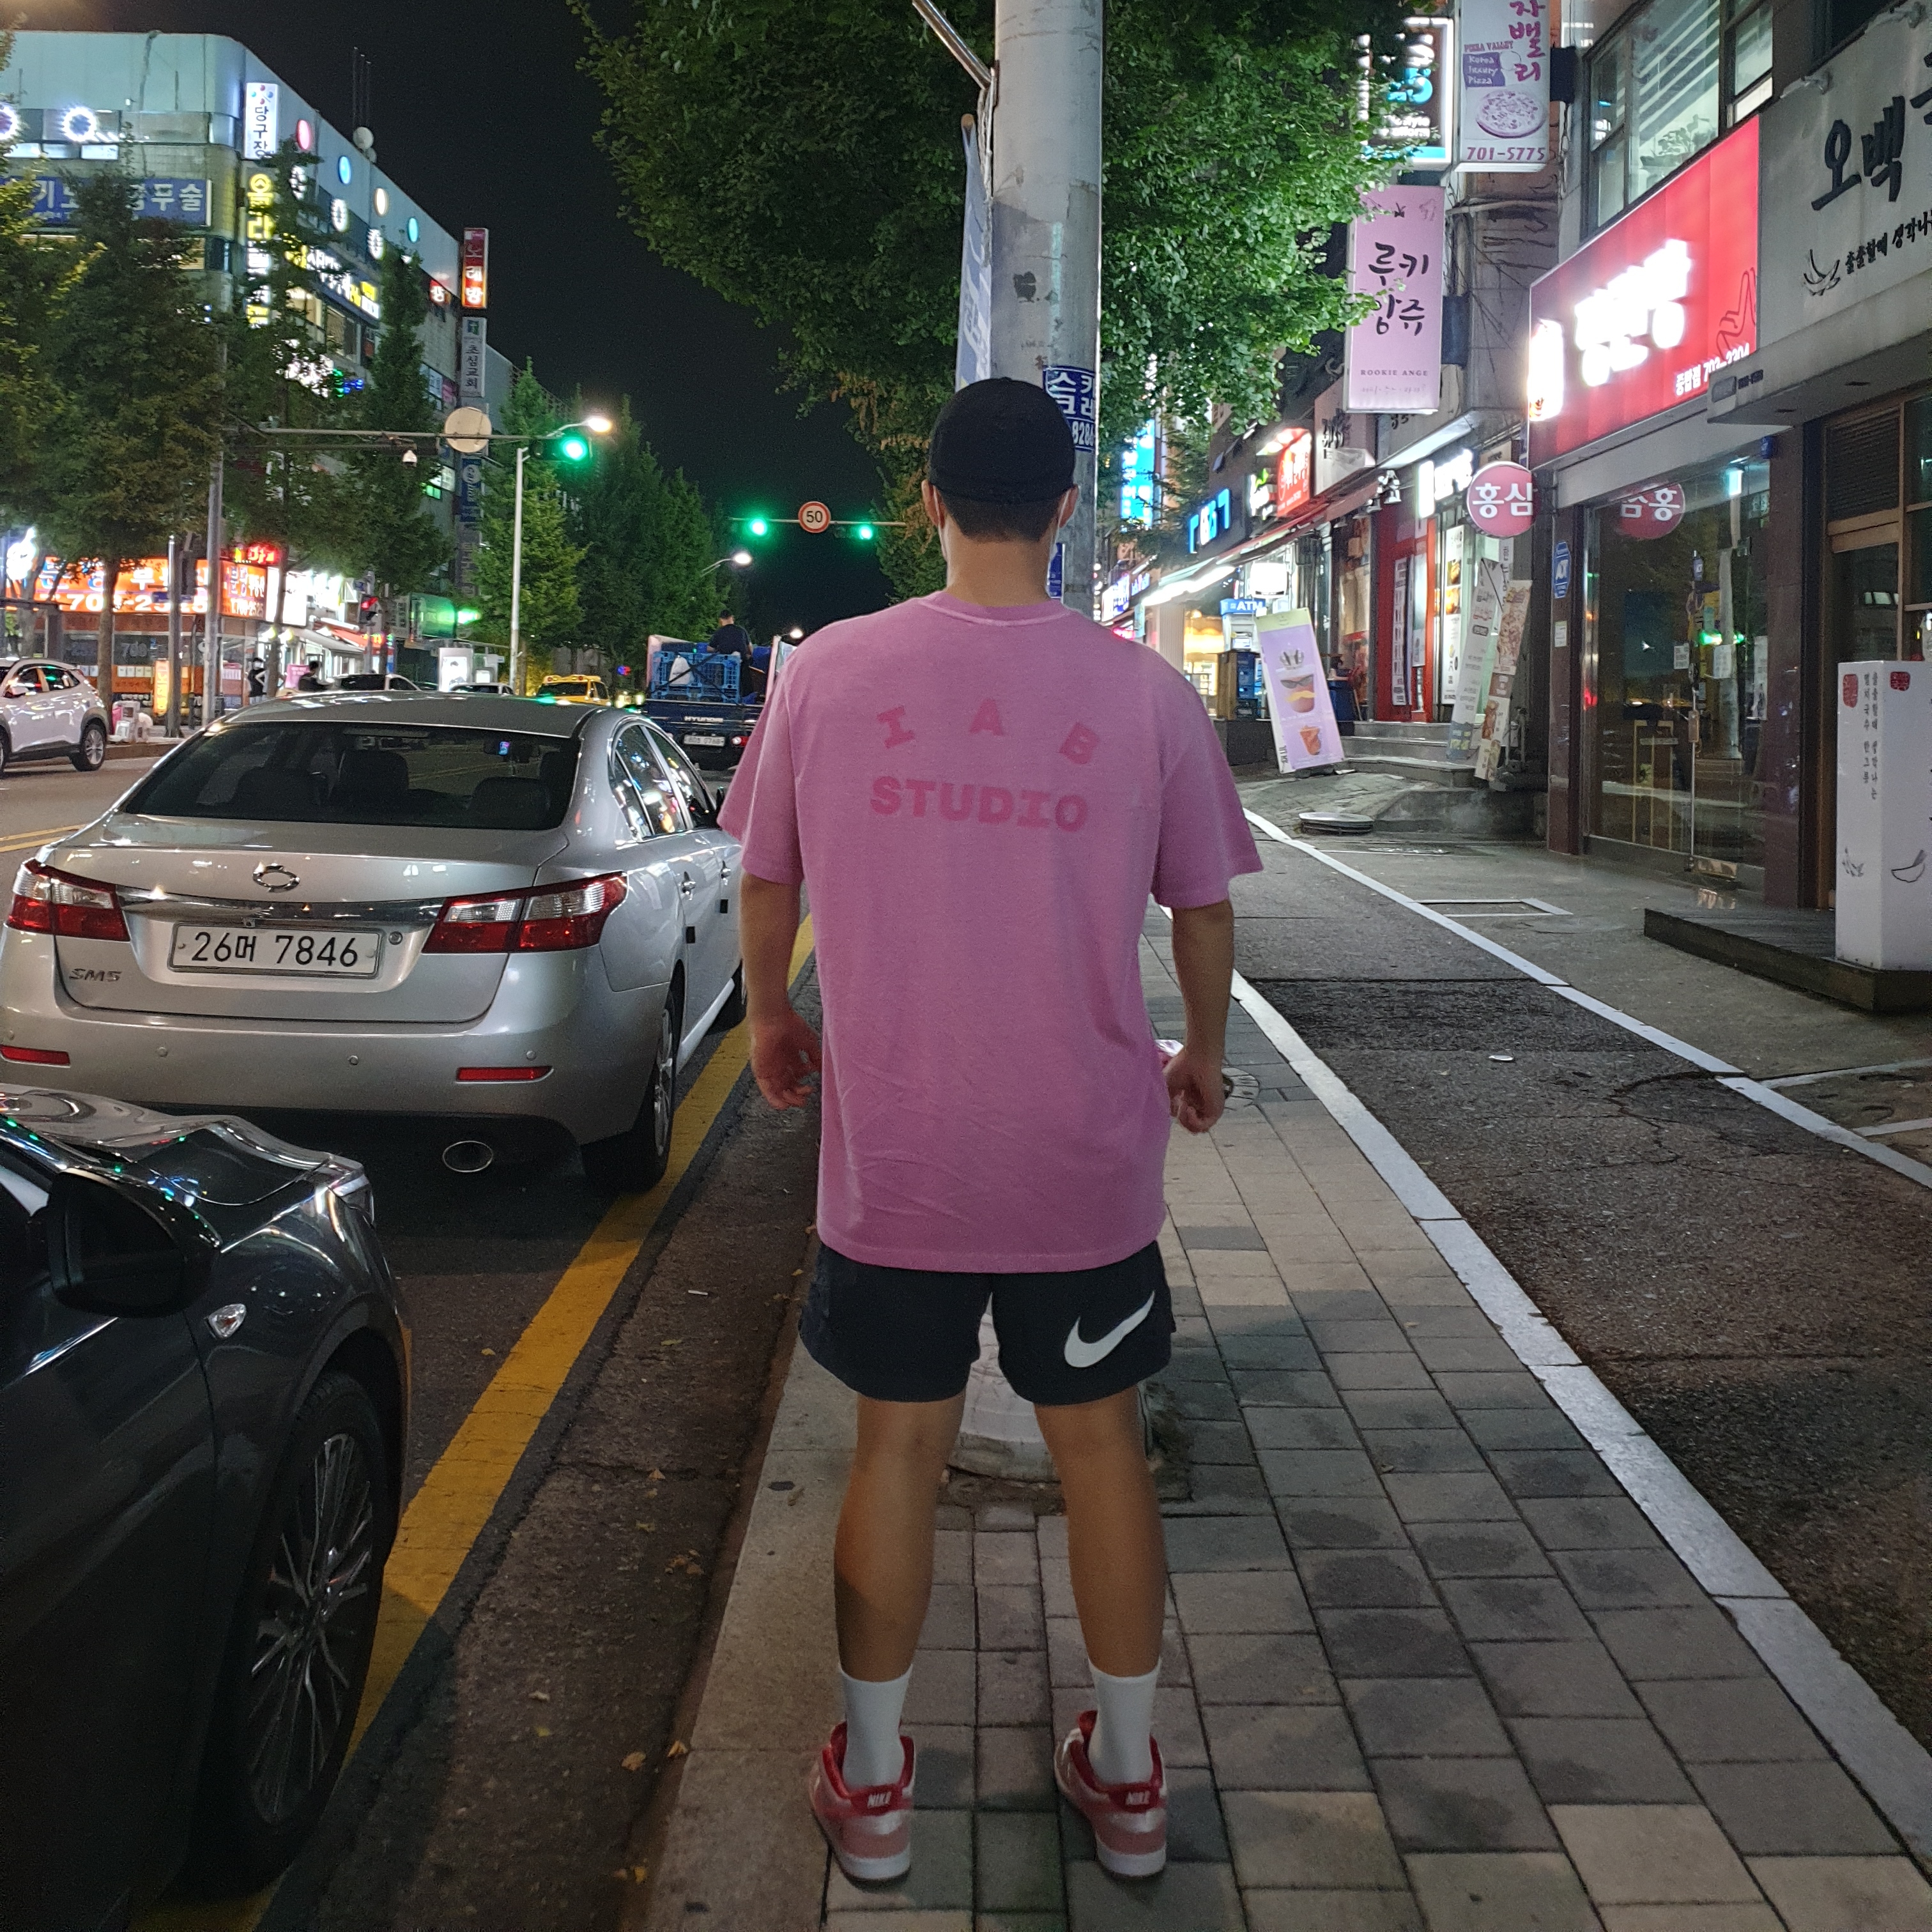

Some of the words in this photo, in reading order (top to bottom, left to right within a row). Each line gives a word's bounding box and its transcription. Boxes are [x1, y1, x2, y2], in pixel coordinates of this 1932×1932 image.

[253, 106, 270, 157] 당구장
[1468, 147, 1545, 160] 701-5775
[1892, 210, 1932, 249] 생각나
[1368, 241, 1429, 286] 루키
[806, 510, 823, 523] 50
[1237, 601, 1263, 611] ATM
[870, 776, 1087, 832] STUDIO
[192, 931, 257, 962] 26머
[275, 935, 358, 967] 7846
[69, 967, 122, 982] SM5
[867, 1791, 892, 1809] NIKE
